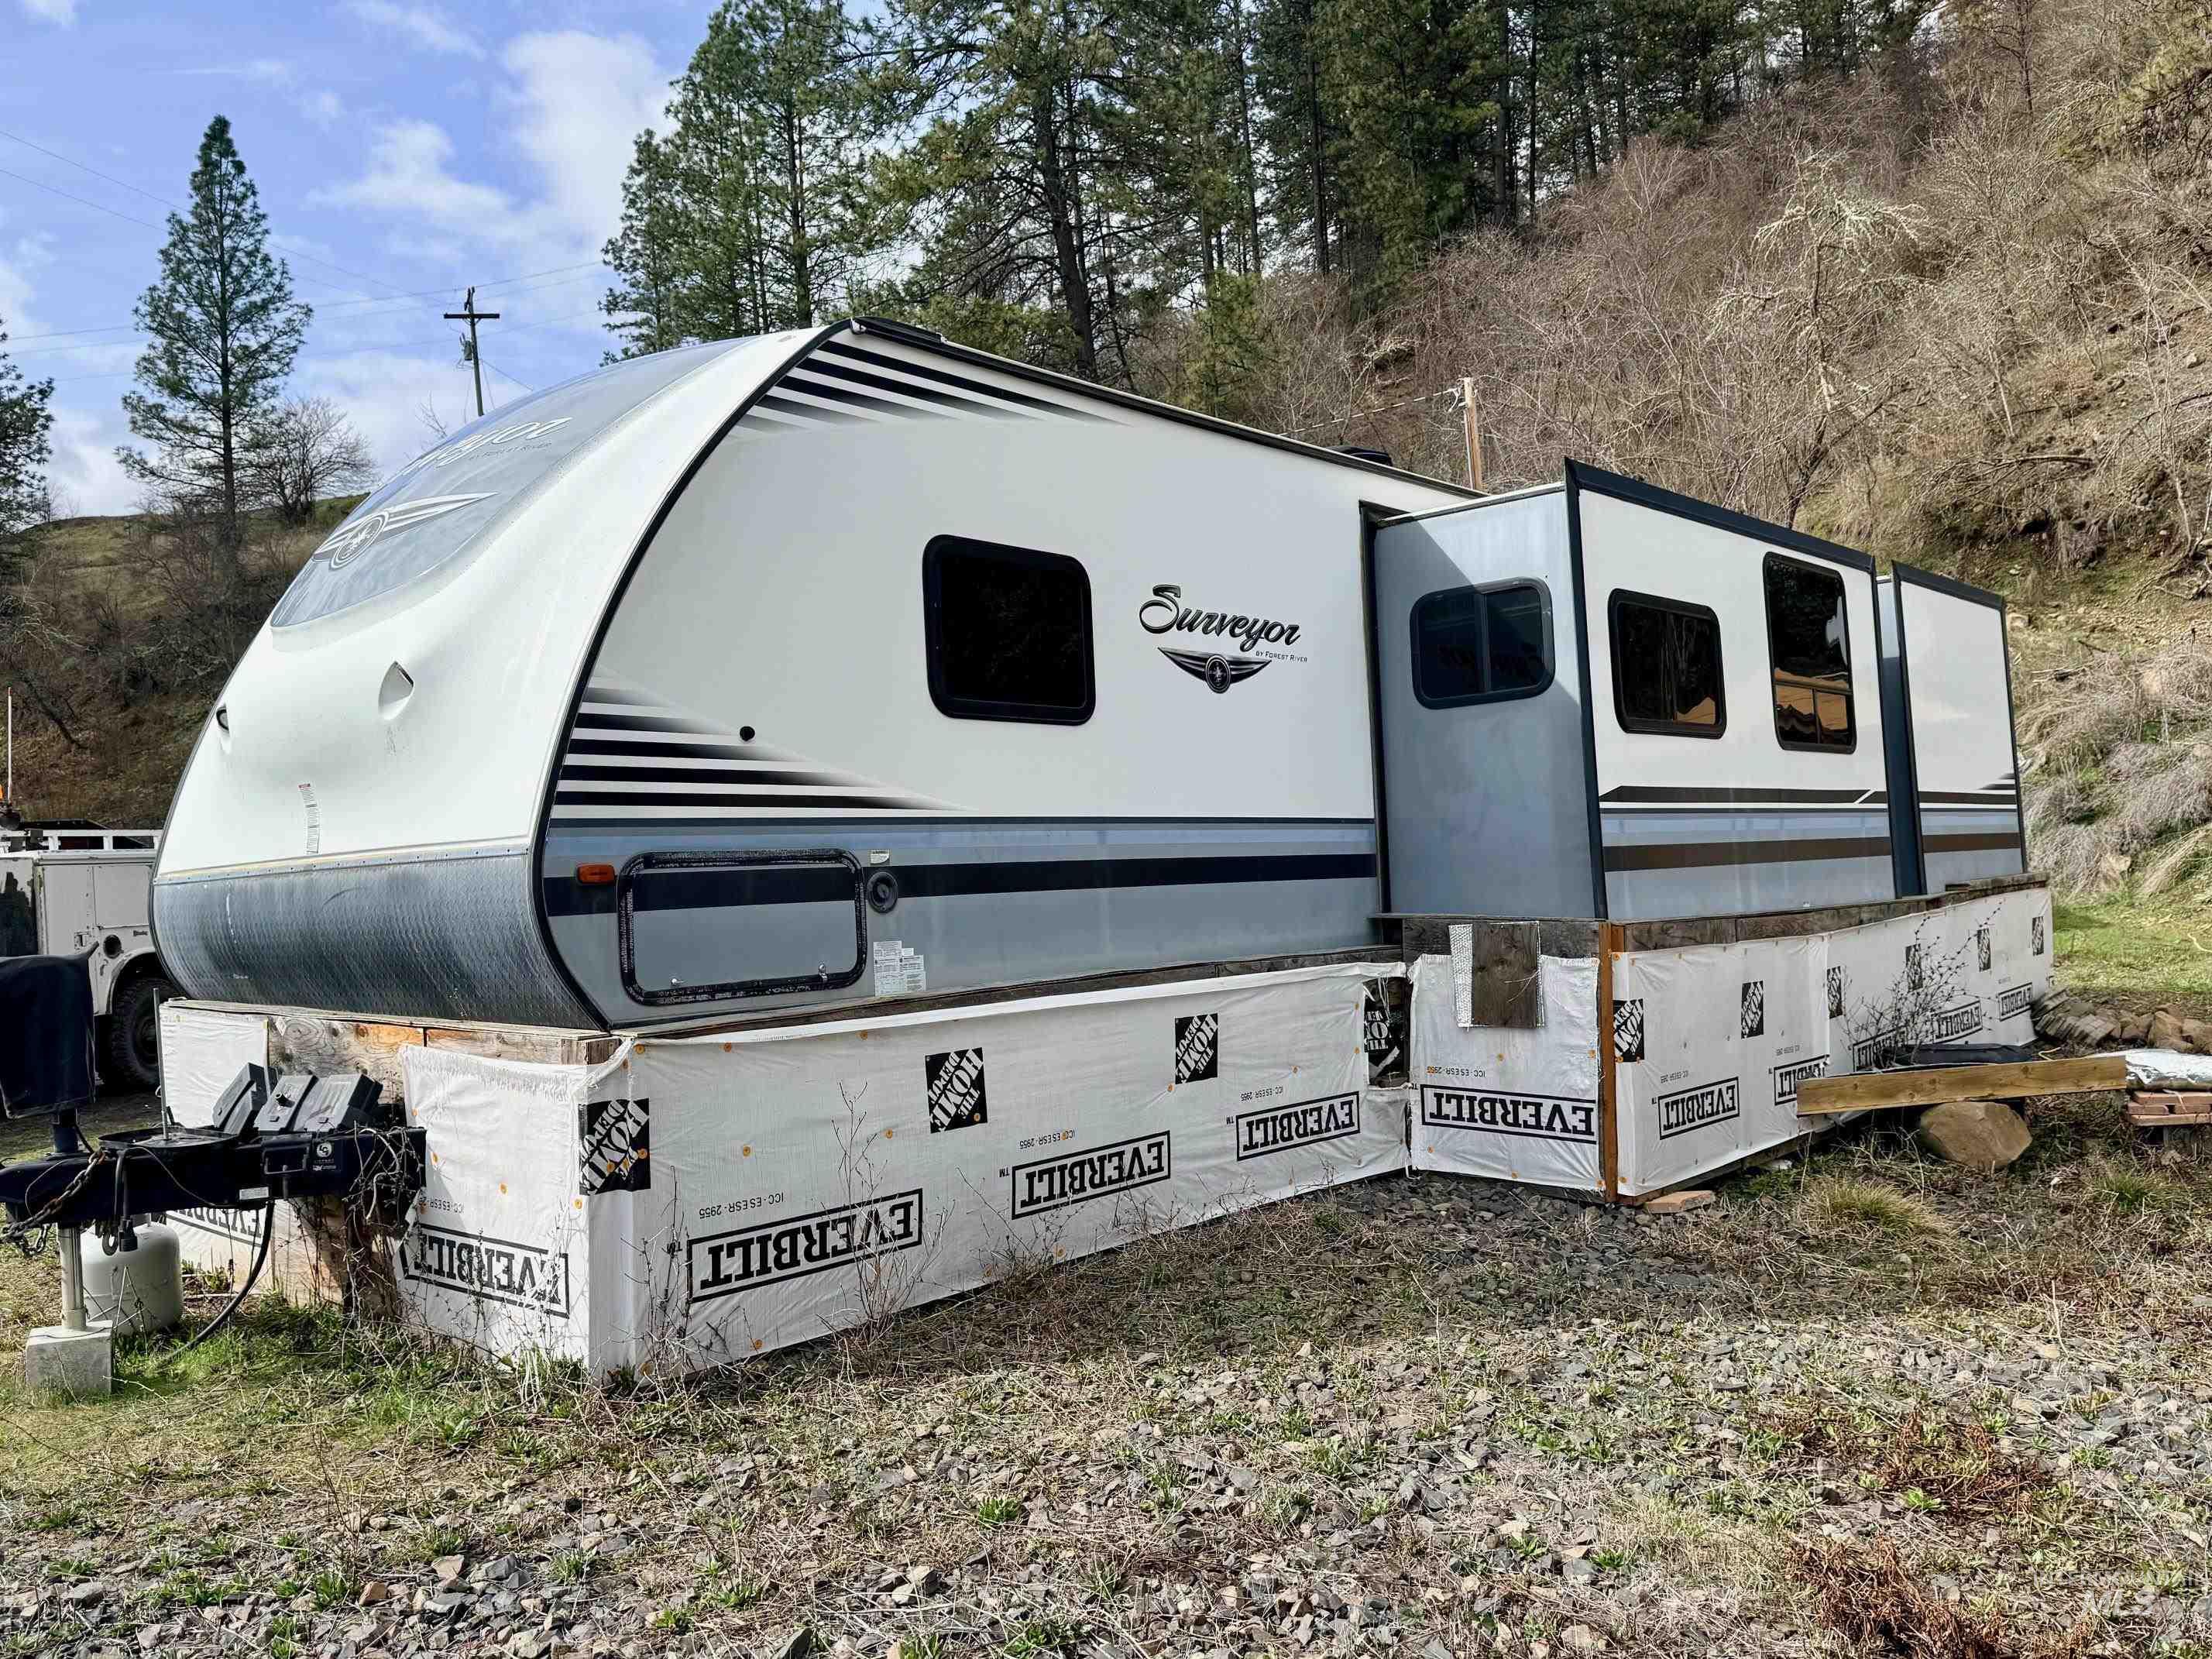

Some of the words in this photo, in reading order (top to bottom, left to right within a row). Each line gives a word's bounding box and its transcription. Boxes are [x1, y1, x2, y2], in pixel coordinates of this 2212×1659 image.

[1139, 584, 1301, 652] Surveyor
[1265, 651, 1289, 660] FOREST
[1176, 1015, 1202, 1060] DEPOT
[1176, 1015, 1218, 1084] HOME
[1196, 1046, 1214, 1074] THE
[929, 1052, 961, 1104] DEPOT
[930, 1049, 983, 1132] HOME
[958, 1087, 981, 1120] THE
[1242, 1100, 1355, 1152] EVERBILT
[1430, 1092, 1595, 1137] EVERBILT
[1663, 1084, 1736, 1132] EVERBILT
[1020, 1141, 1165, 1208] EVERBILT
[700, 1200, 914, 1290] EVERBILT
